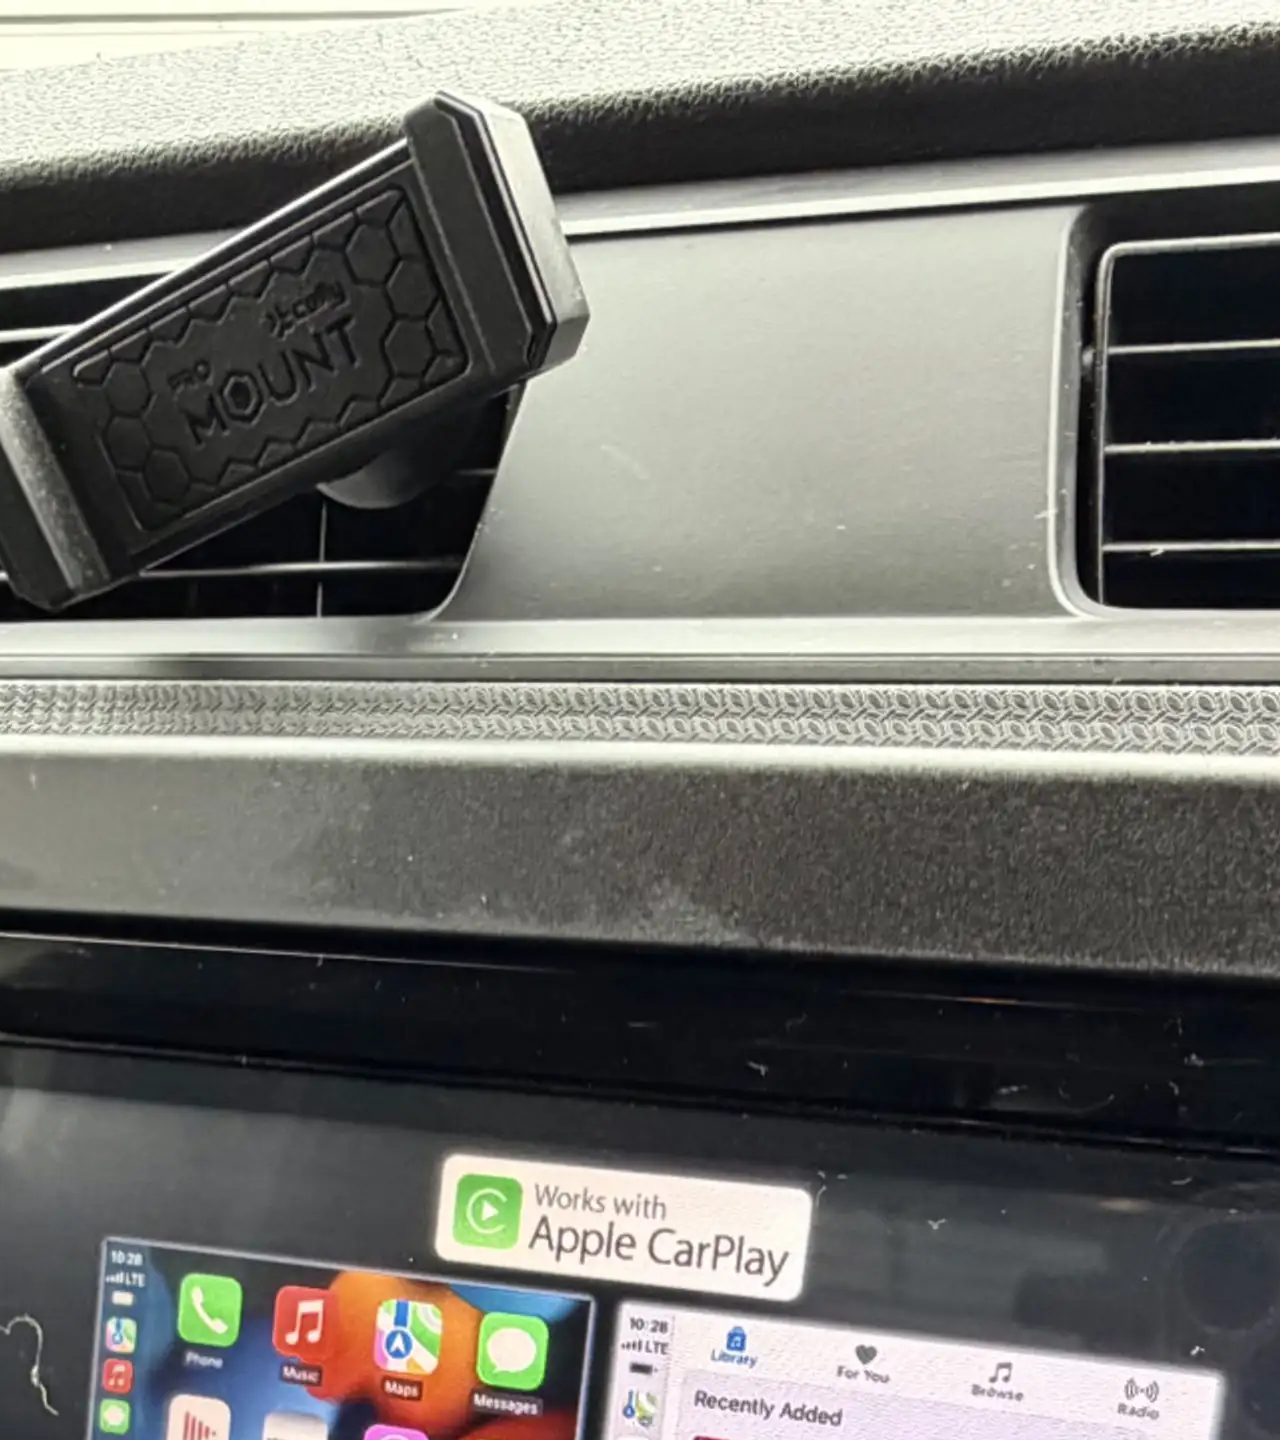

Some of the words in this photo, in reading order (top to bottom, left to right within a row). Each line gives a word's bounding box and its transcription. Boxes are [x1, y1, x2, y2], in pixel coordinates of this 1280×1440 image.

[178, 312, 362, 450] MOUNT
[534, 1184, 606, 1213] Works
[613, 1193, 667, 1221] with
[528, 1215, 637, 1265] Apple
[648, 1228, 791, 1288] CarPlay
[125, 1273, 145, 1288] LTE
[644, 1340, 669, 1355] LTE
[185, 1352, 223, 1369] Phone
[710, 1349, 757, 1368] Library
[282, 1366, 320, 1382] Music
[836, 1366, 859, 1380] For
[864, 1369, 890, 1384] You
[383, 1380, 419, 1398] Maps
[971, 1384, 1024, 1402] Browse
[473, 1392, 538, 1416] Messages
[694, 1389, 775, 1420] Recently
[778, 1402, 843, 1427] Added
[1117, 1403, 1160, 1420] Radio
